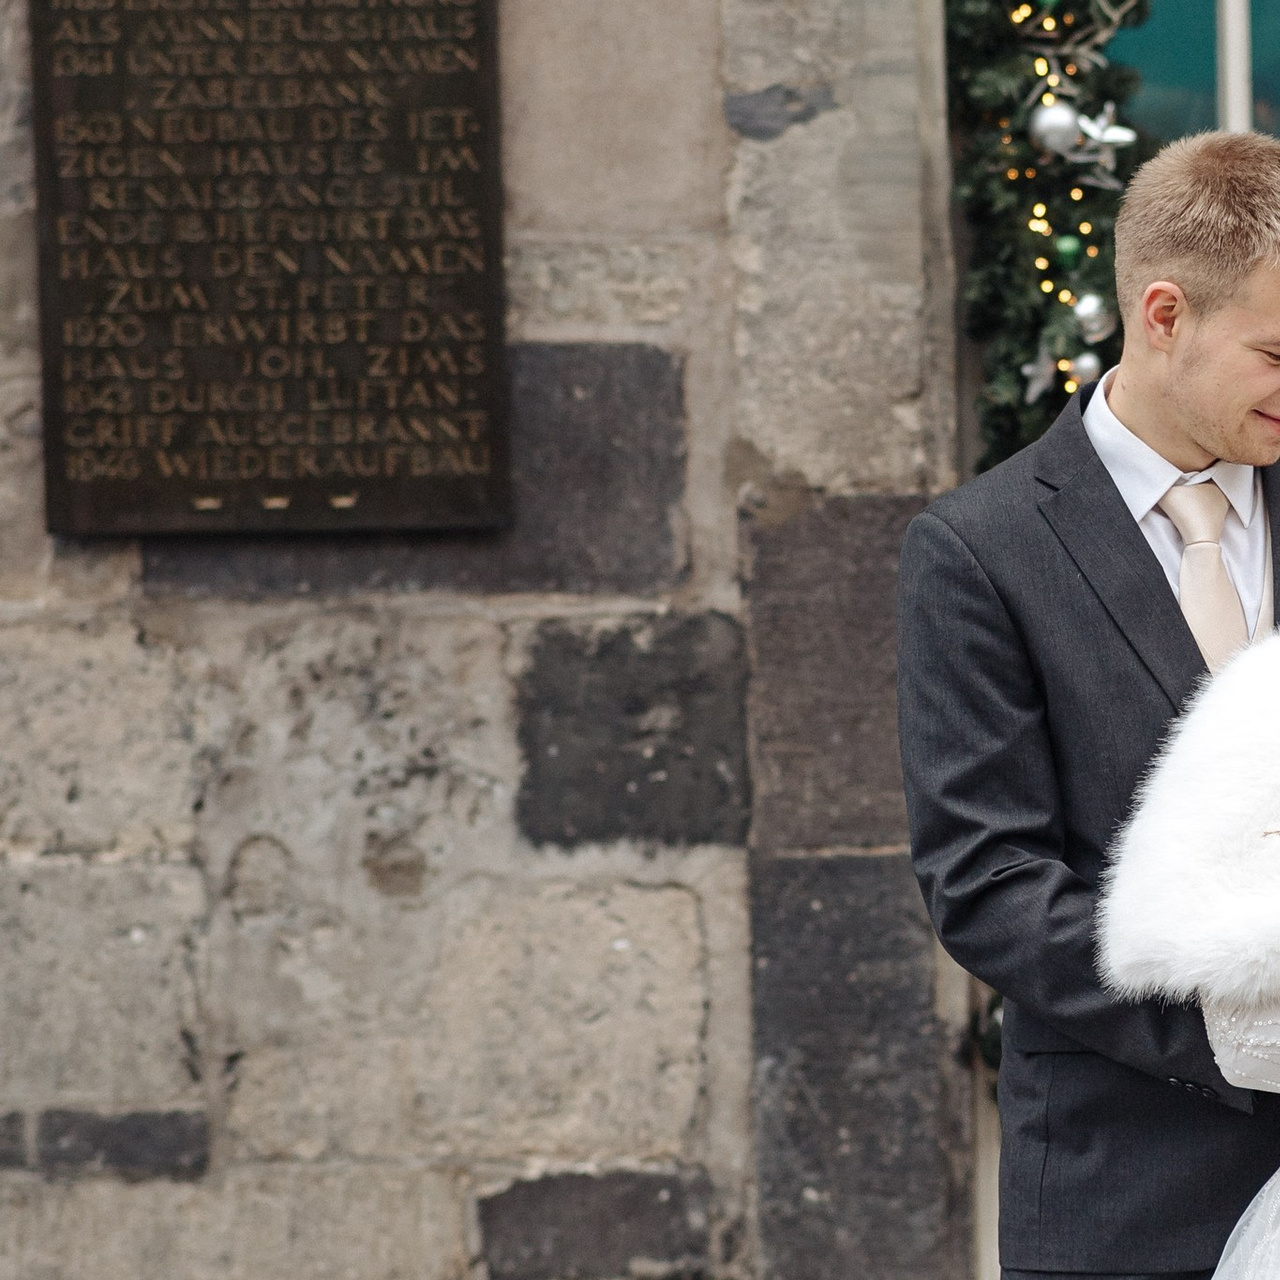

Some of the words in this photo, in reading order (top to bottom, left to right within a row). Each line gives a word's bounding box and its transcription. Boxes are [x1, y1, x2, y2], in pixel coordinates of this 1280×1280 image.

[53, 14, 121, 45] ALS
[126, 45, 236, 77] UNTER
[246, 44, 331, 76] DEM
[346, 42, 479, 74] NAMEN
[133, 110, 293, 144] NEUBAU
[311, 110, 390, 143] DES
[58, 146, 184, 179] ZIGEN
[214, 145, 386, 178] HAUSES
[417, 144, 481, 174] IM
[89, 176, 465, 211] RENAISSANCESTIL
[57, 211, 162, 245] ENDE
[405, 208, 482, 241] DAS
[58, 247, 184, 280] HAUS
[212, 245, 299, 279] DEN
[324, 242, 485, 276] NAMEN
[171, 312, 376, 347] ERWIRBT
[402, 310, 486, 343] DAS
[62, 348, 184, 382] HAUS
[367, 344, 484, 377] ZIMS
[148, 380, 284, 414] DURCH
[307, 378, 477, 412] LUFTAN-
[62, 414, 182, 448] GRIFF
[201, 410, 488, 447] AUSGEBRANNT
[155, 444, 490, 480] WIEDERAUFBAU
